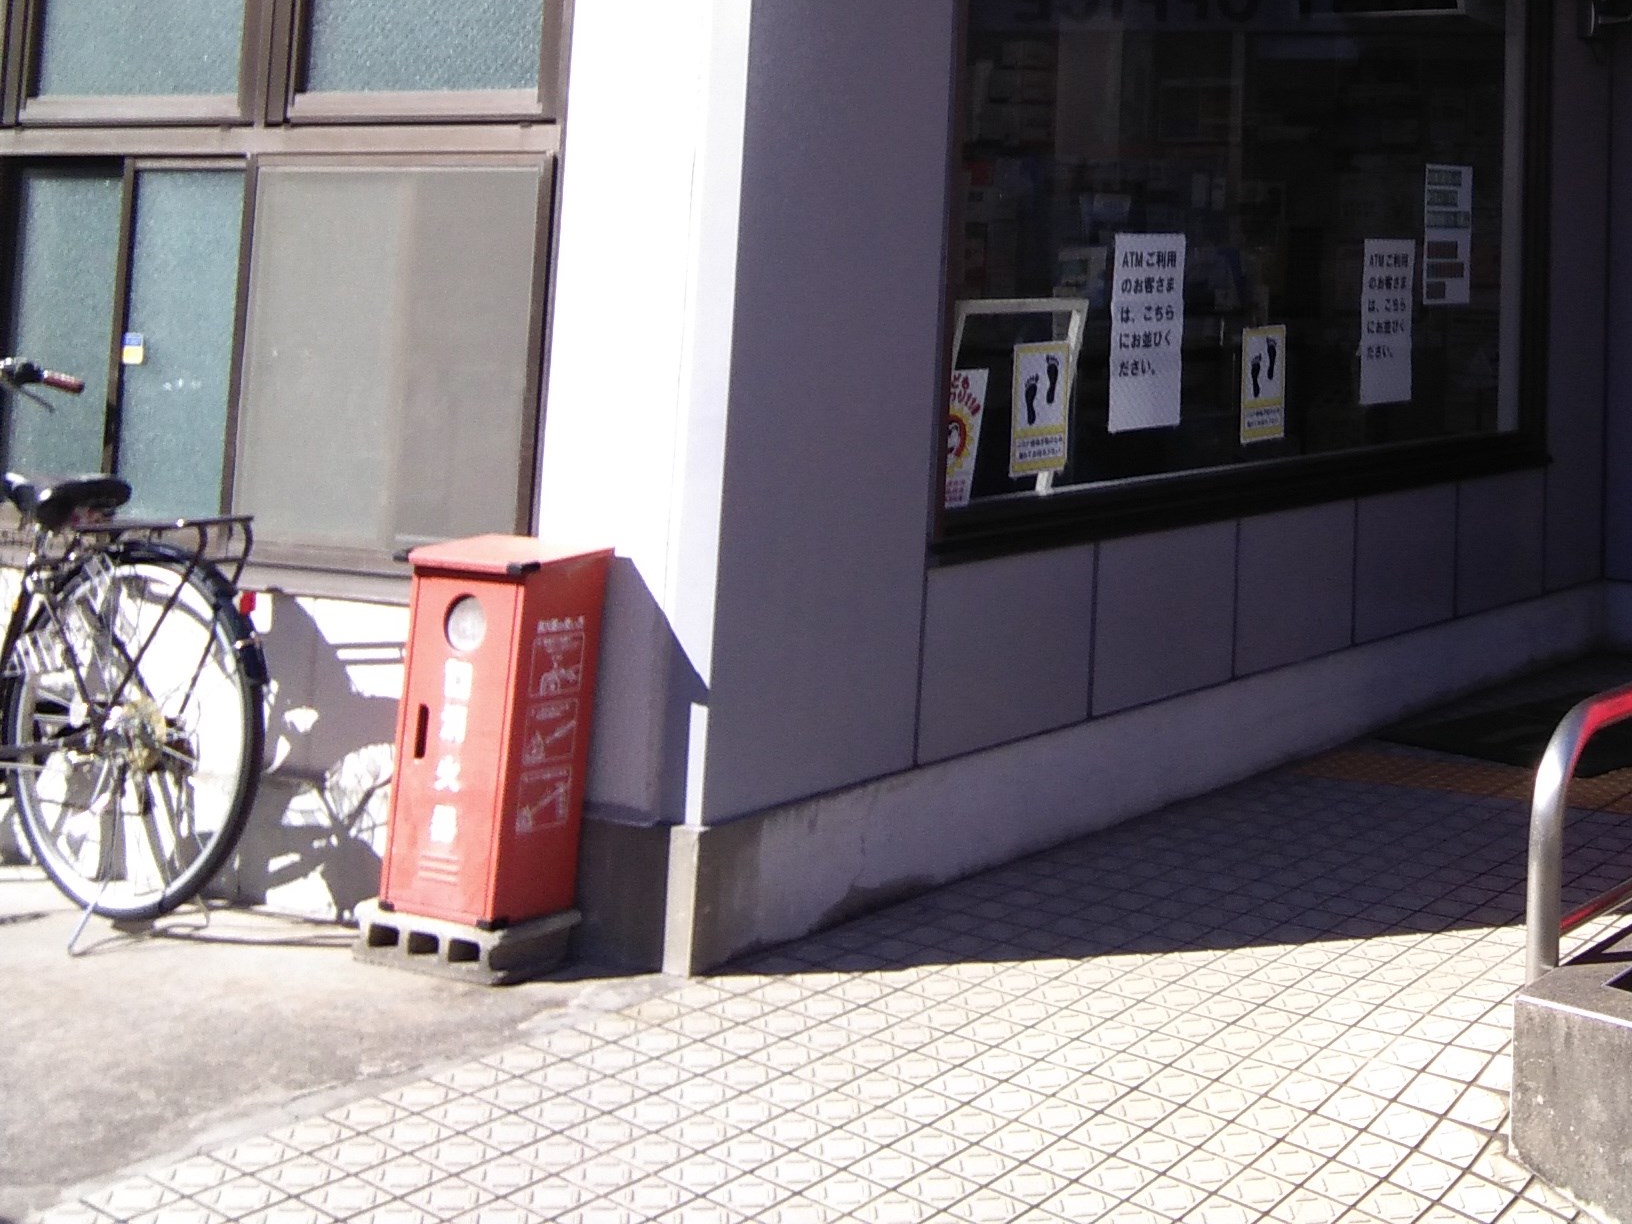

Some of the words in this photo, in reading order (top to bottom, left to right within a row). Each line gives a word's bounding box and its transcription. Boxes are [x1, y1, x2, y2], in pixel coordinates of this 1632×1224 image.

[1121, 277, 1175, 294] のお客さま
[1120, 305, 1175, 324] は、こちら
[1118, 360, 1156, 378] ださい。
